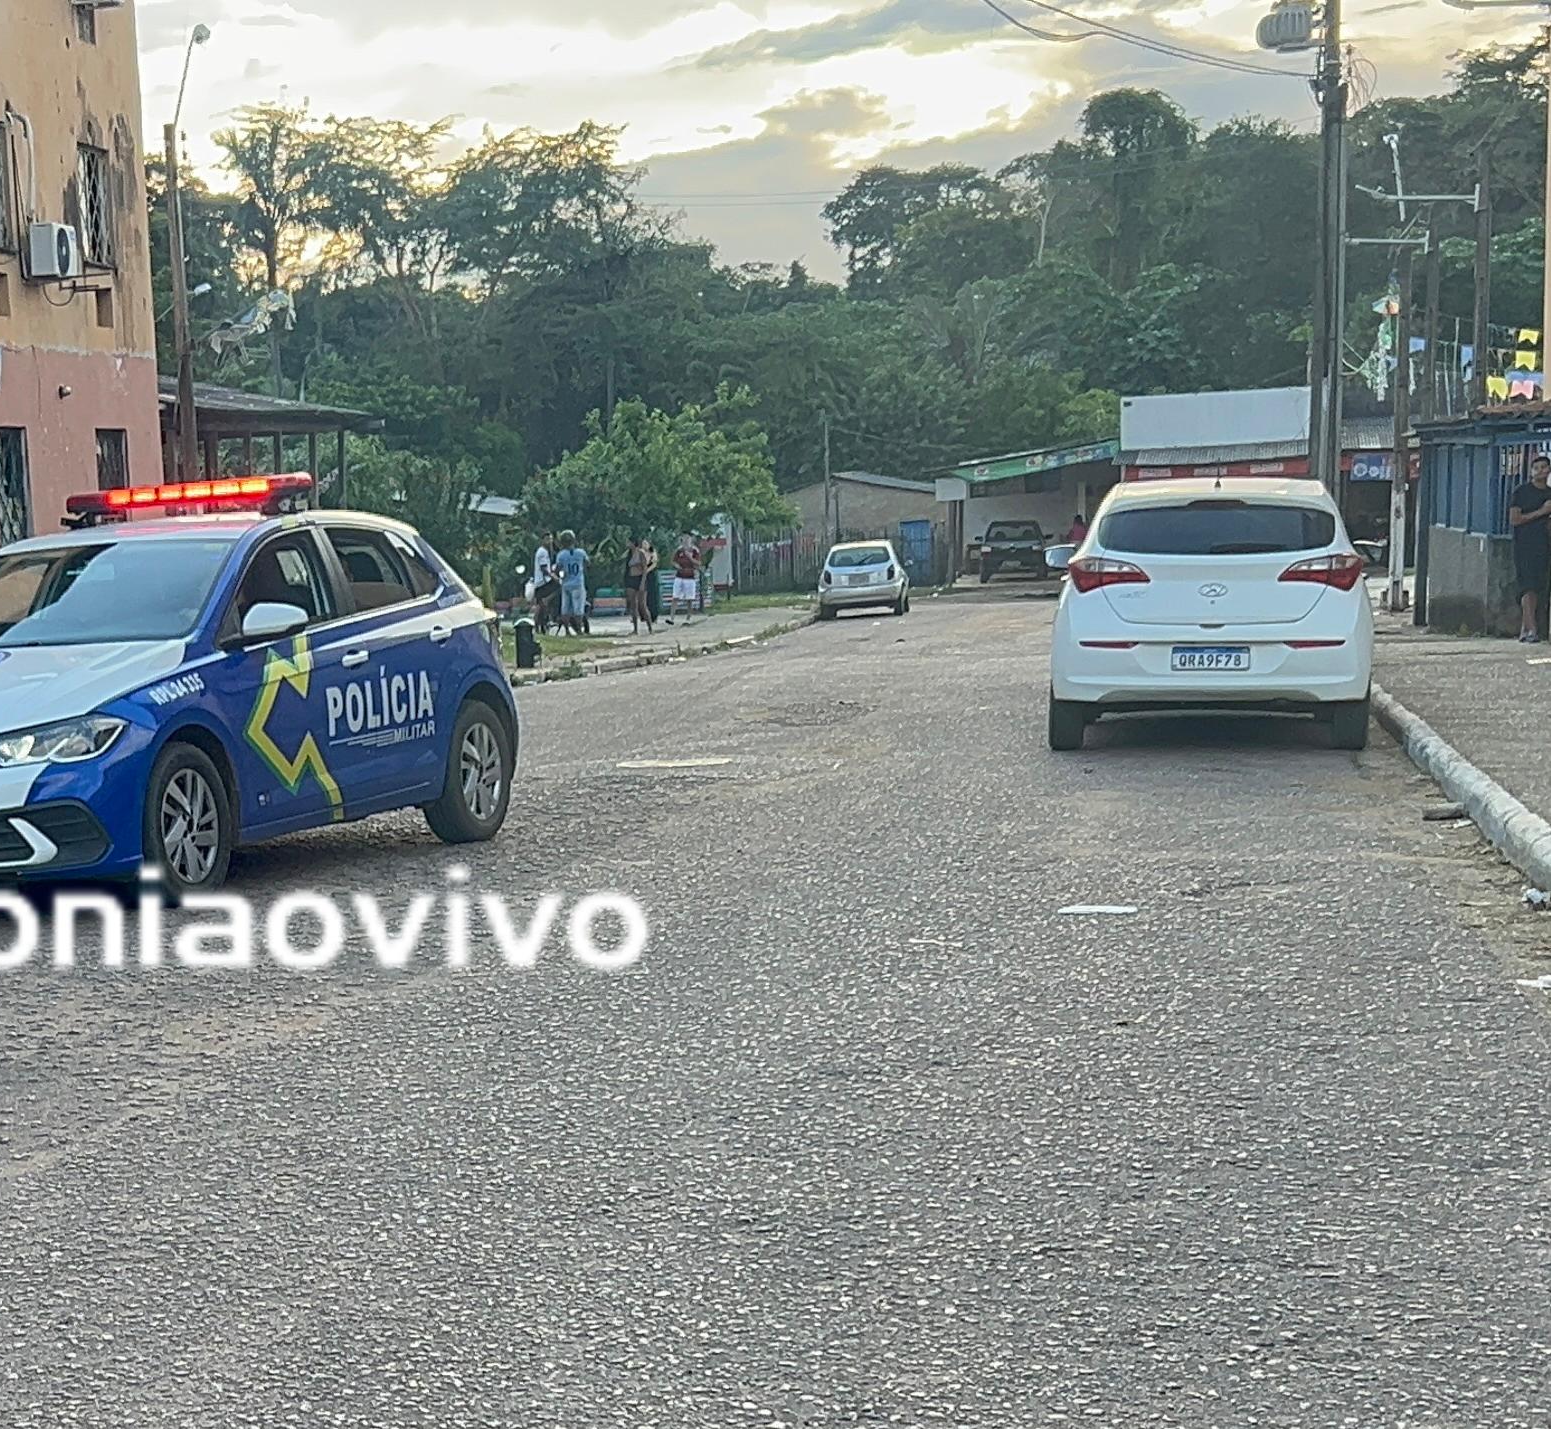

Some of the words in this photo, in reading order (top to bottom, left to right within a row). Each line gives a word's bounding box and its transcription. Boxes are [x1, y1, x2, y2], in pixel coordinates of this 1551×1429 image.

[567, 563, 580, 577] 10
[1178, 654, 1242, 667] QRA9F78
[326, 664, 434, 737] POLÍCIA
[393, 720, 435, 743] MILITAR
